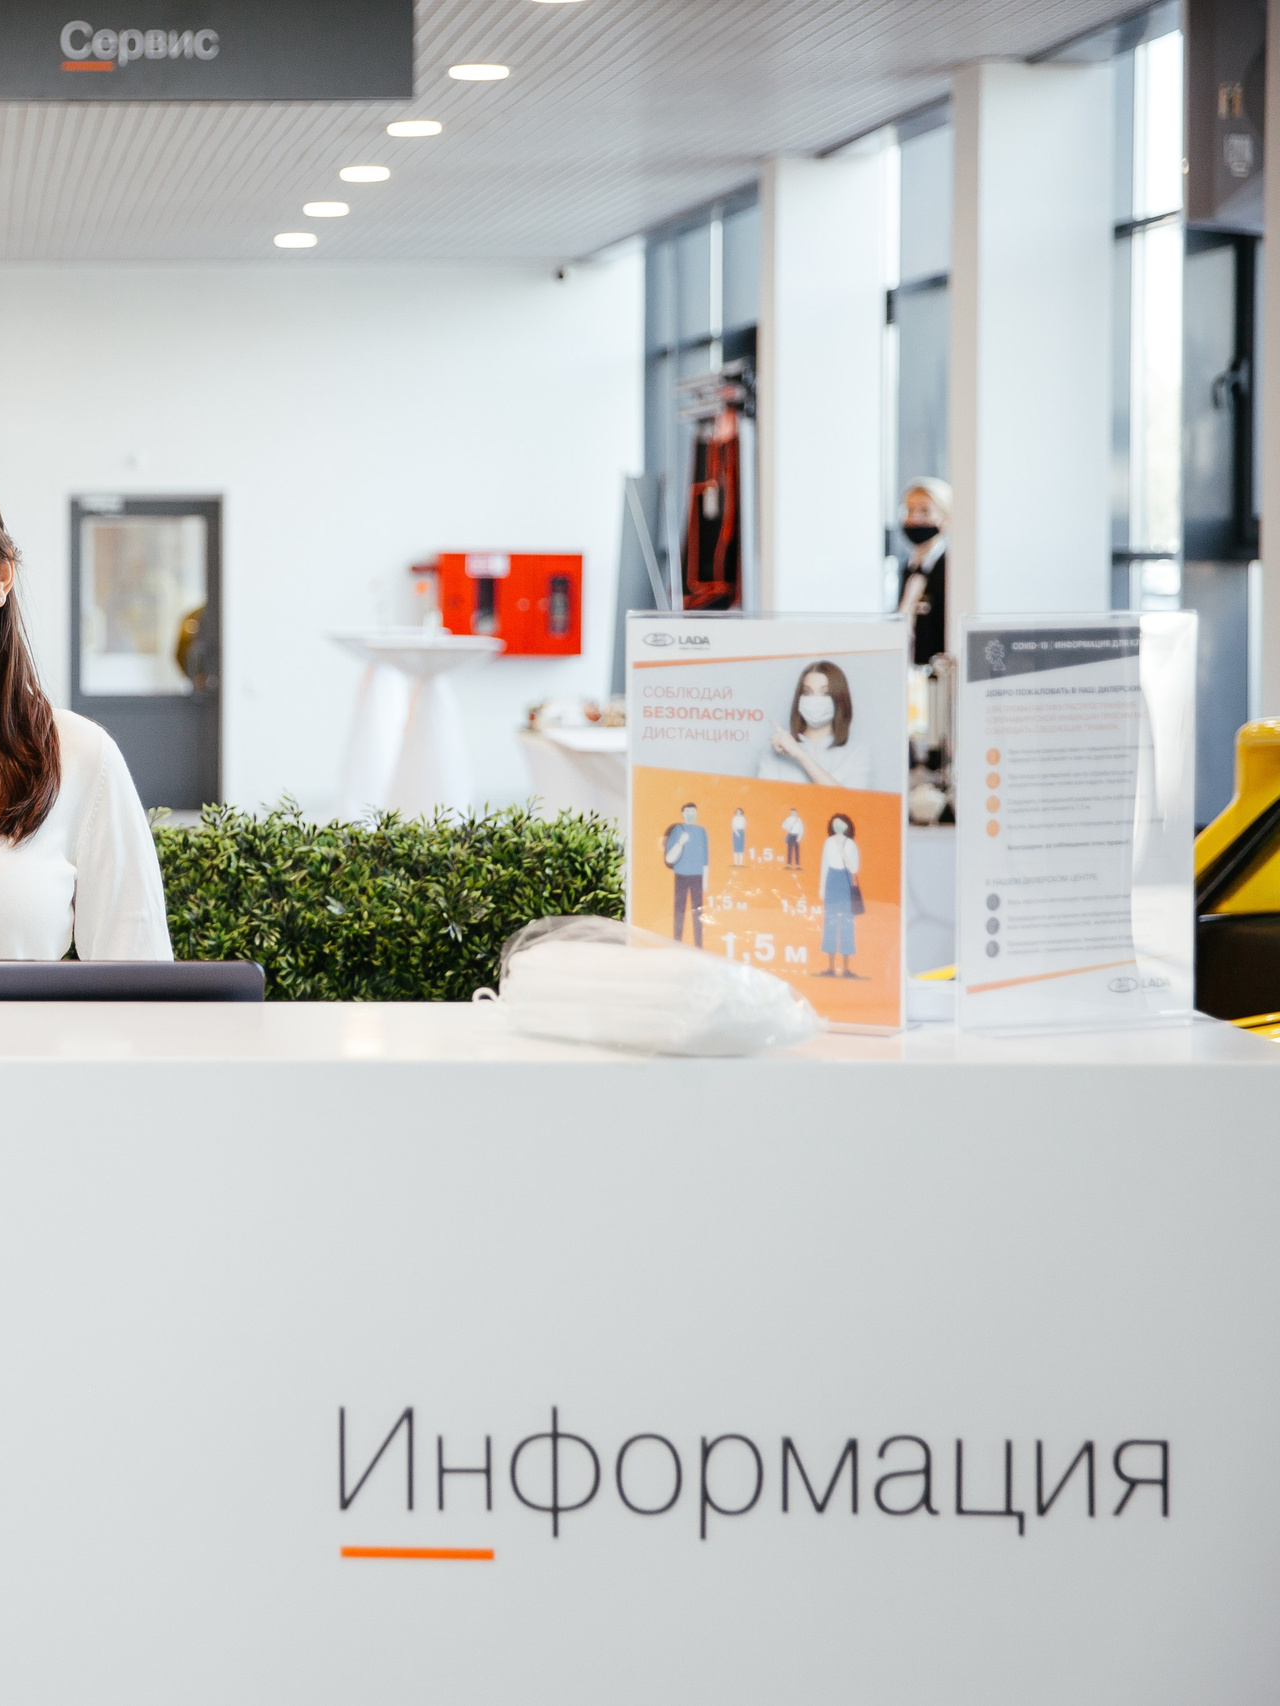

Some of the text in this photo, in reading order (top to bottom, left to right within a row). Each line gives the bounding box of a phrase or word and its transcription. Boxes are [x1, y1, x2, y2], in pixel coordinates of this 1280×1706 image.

[59, 19, 220, 67] Сервис
[678, 635, 711, 646] LADA
[1054, 639, 1111, 649] ИНФОРМАЦИЯ
[642, 685, 733, 701] СОБЛЮДАЙ
[642, 705, 764, 722] БЕЗОПАСНУЮ
[641, 725, 750, 743] ДИСТАНЦИЮ!
[748, 847, 774, 863] 1,5
[707, 894, 733, 913] 1,5
[780, 898, 808, 916] 1,5
[720, 931, 808, 965] 1,5 м
[338, 1405, 1170, 1542] Информация
